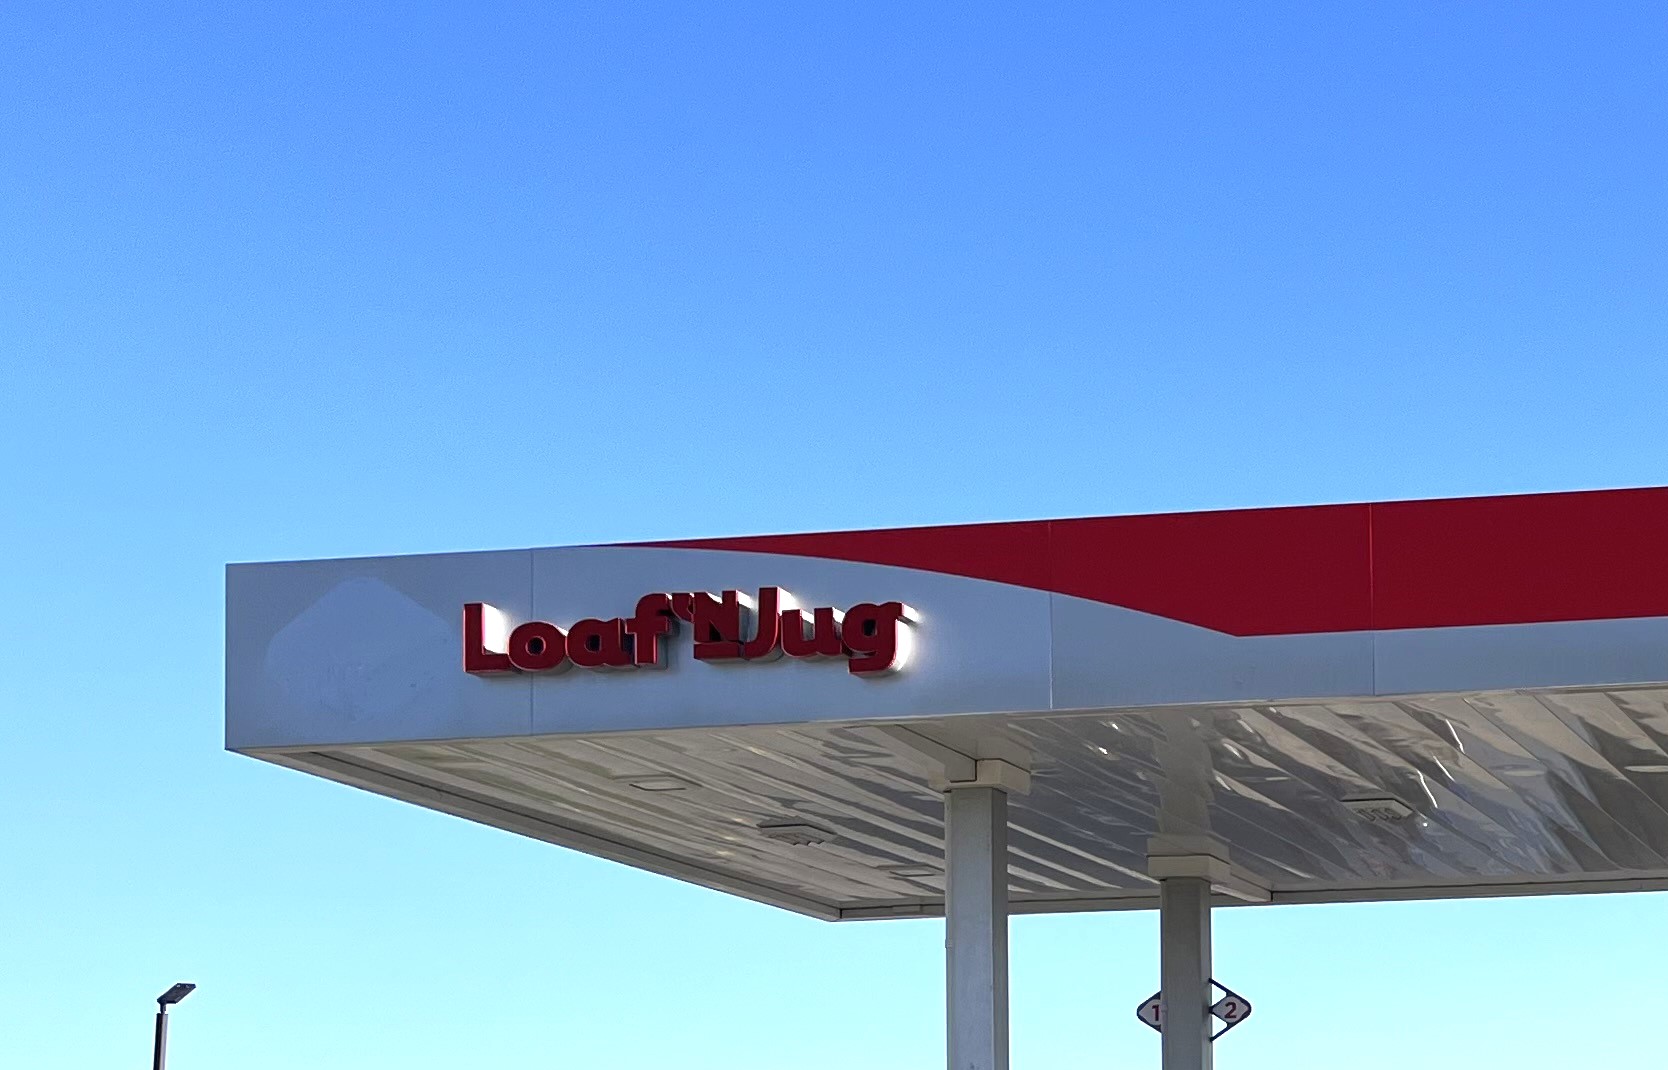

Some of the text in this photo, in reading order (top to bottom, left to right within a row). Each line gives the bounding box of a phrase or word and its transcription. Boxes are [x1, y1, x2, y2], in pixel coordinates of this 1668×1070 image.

[463, 593, 671, 674] Loaf
[743, 586, 914, 677] Jug
[1151, 1004, 1160, 1022] 1
[1224, 1001, 1238, 1019] 2
